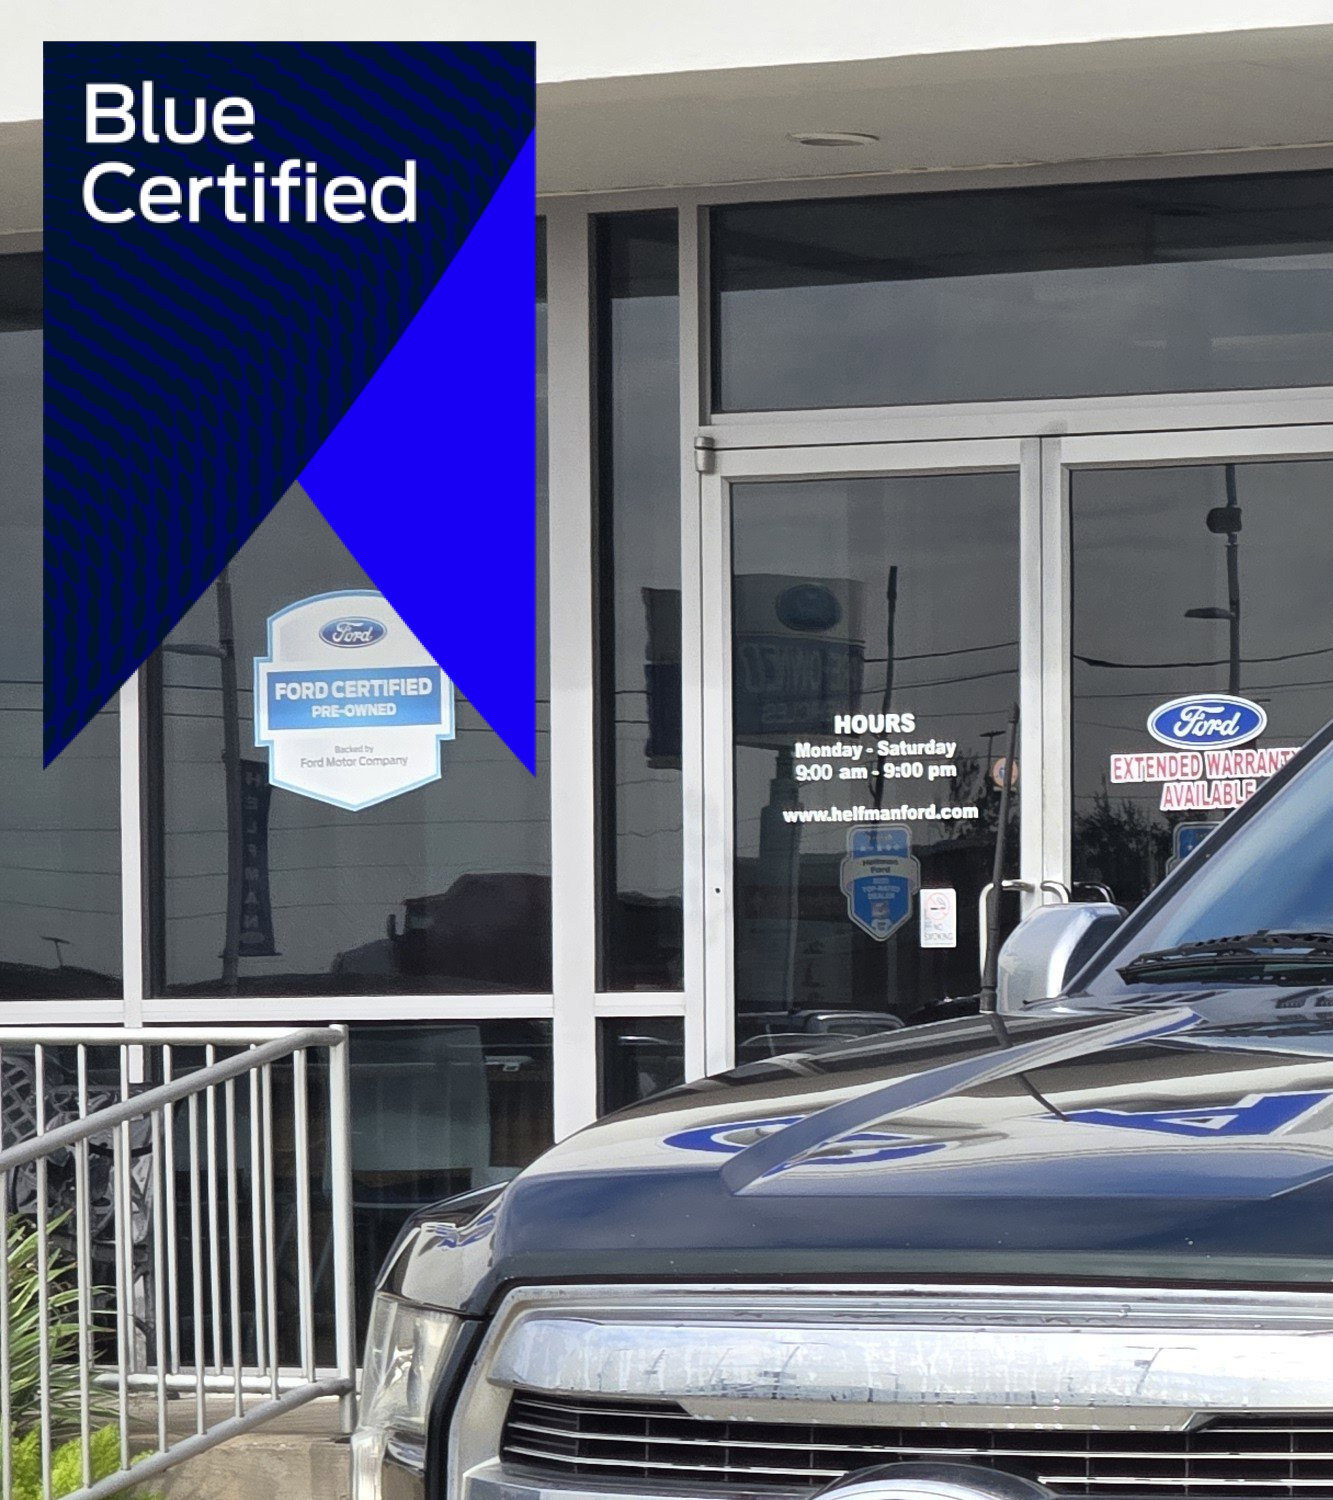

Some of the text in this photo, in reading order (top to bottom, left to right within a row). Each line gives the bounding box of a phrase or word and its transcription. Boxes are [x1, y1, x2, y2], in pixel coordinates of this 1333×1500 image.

[331, 621, 373, 643] Ford
[274, 677, 433, 700] FORD CERTIFIED
[311, 702, 397, 718] PRE-OWNED
[834, 713, 916, 734] HOURS
[1173, 705, 1242, 738] Ford
[334, 745, 374, 754] Backed by
[794, 742, 863, 760] Monday
[877, 739, 957, 759] Saturday
[300, 756, 408, 768] Ford Motor Company
[795, 764, 833, 781] 9:00
[839, 766, 868, 779] am
[883, 762, 923, 778] 9:00
[928, 764, 957, 781] pm
[1113, 750, 1297, 780] EXTENDED WARRANT
[782, 804, 979, 823] www.helfmanford.com
